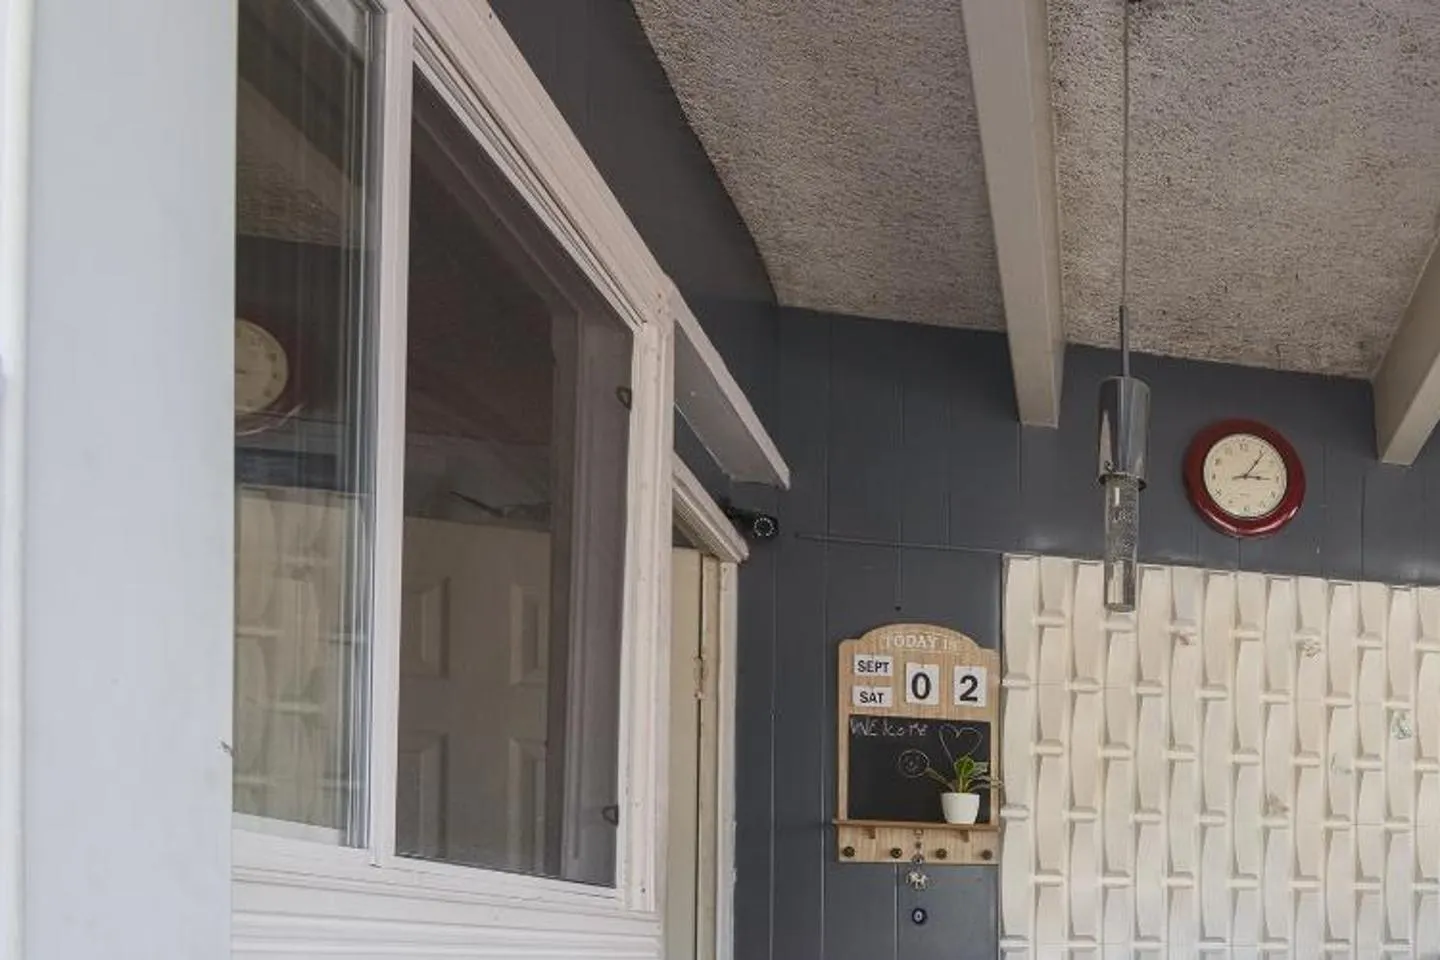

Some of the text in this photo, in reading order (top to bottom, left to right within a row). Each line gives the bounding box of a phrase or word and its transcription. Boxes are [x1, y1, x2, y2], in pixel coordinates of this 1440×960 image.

[886, 633, 937, 649] TODAY
[857, 659, 889, 673] SEPT
[859, 690, 884, 704] SAT
